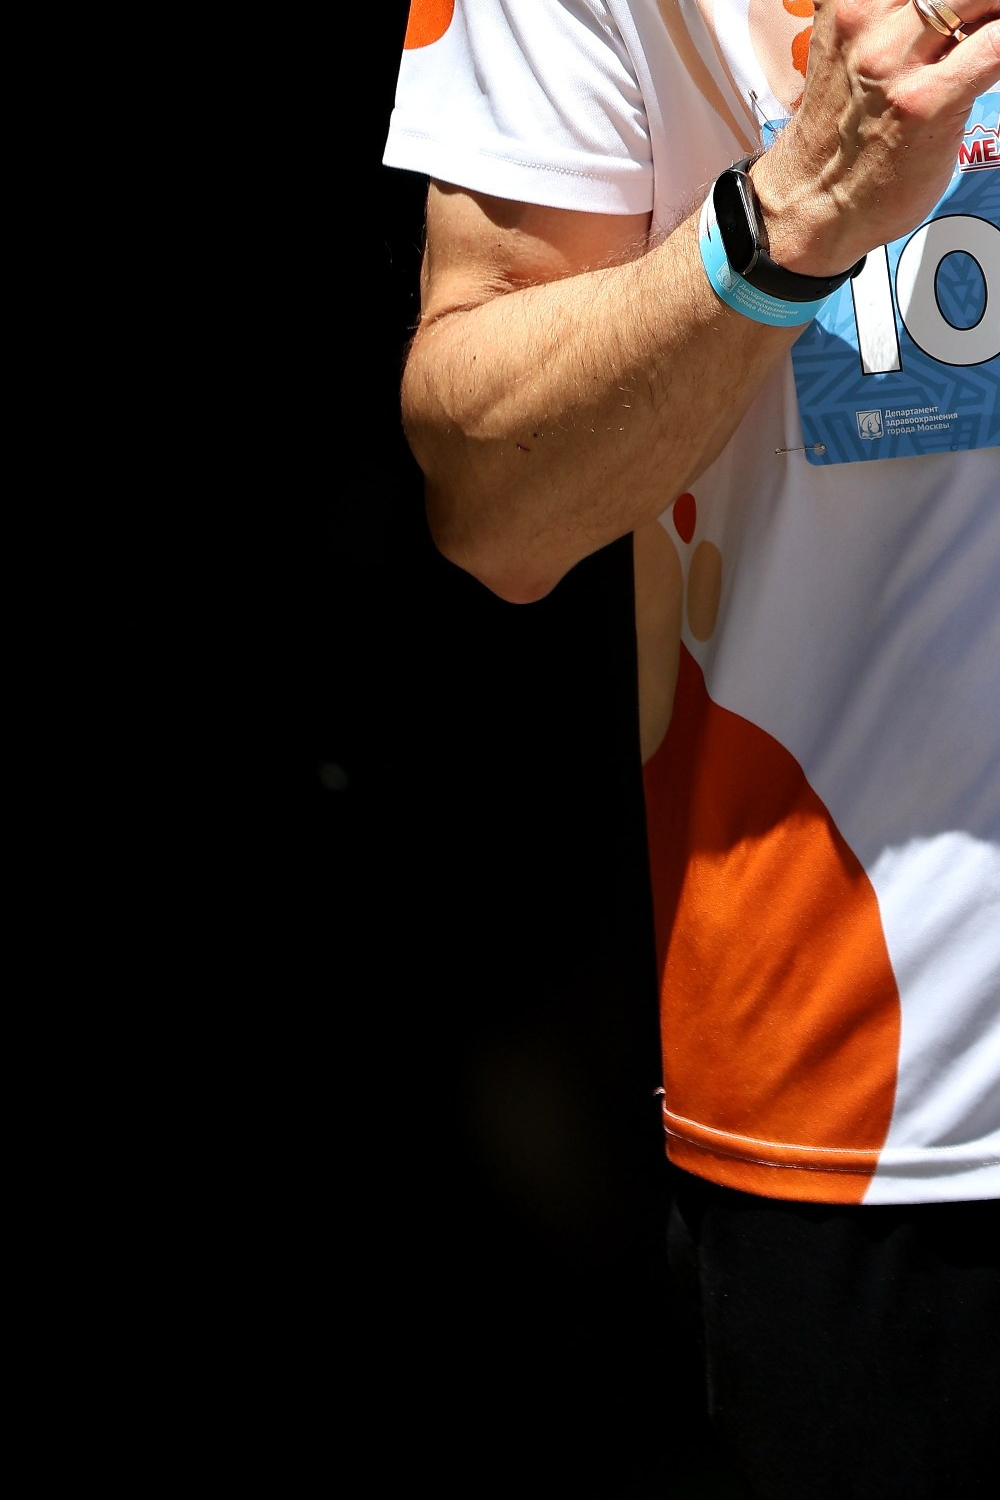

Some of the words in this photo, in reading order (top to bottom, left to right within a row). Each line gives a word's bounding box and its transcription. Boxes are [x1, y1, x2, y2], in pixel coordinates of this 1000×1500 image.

[884, 406, 939, 419] Департамент
[885, 412, 958, 427] здравоохранения
[887, 425, 916, 436] города
[917, 422, 950, 432] Москвы
